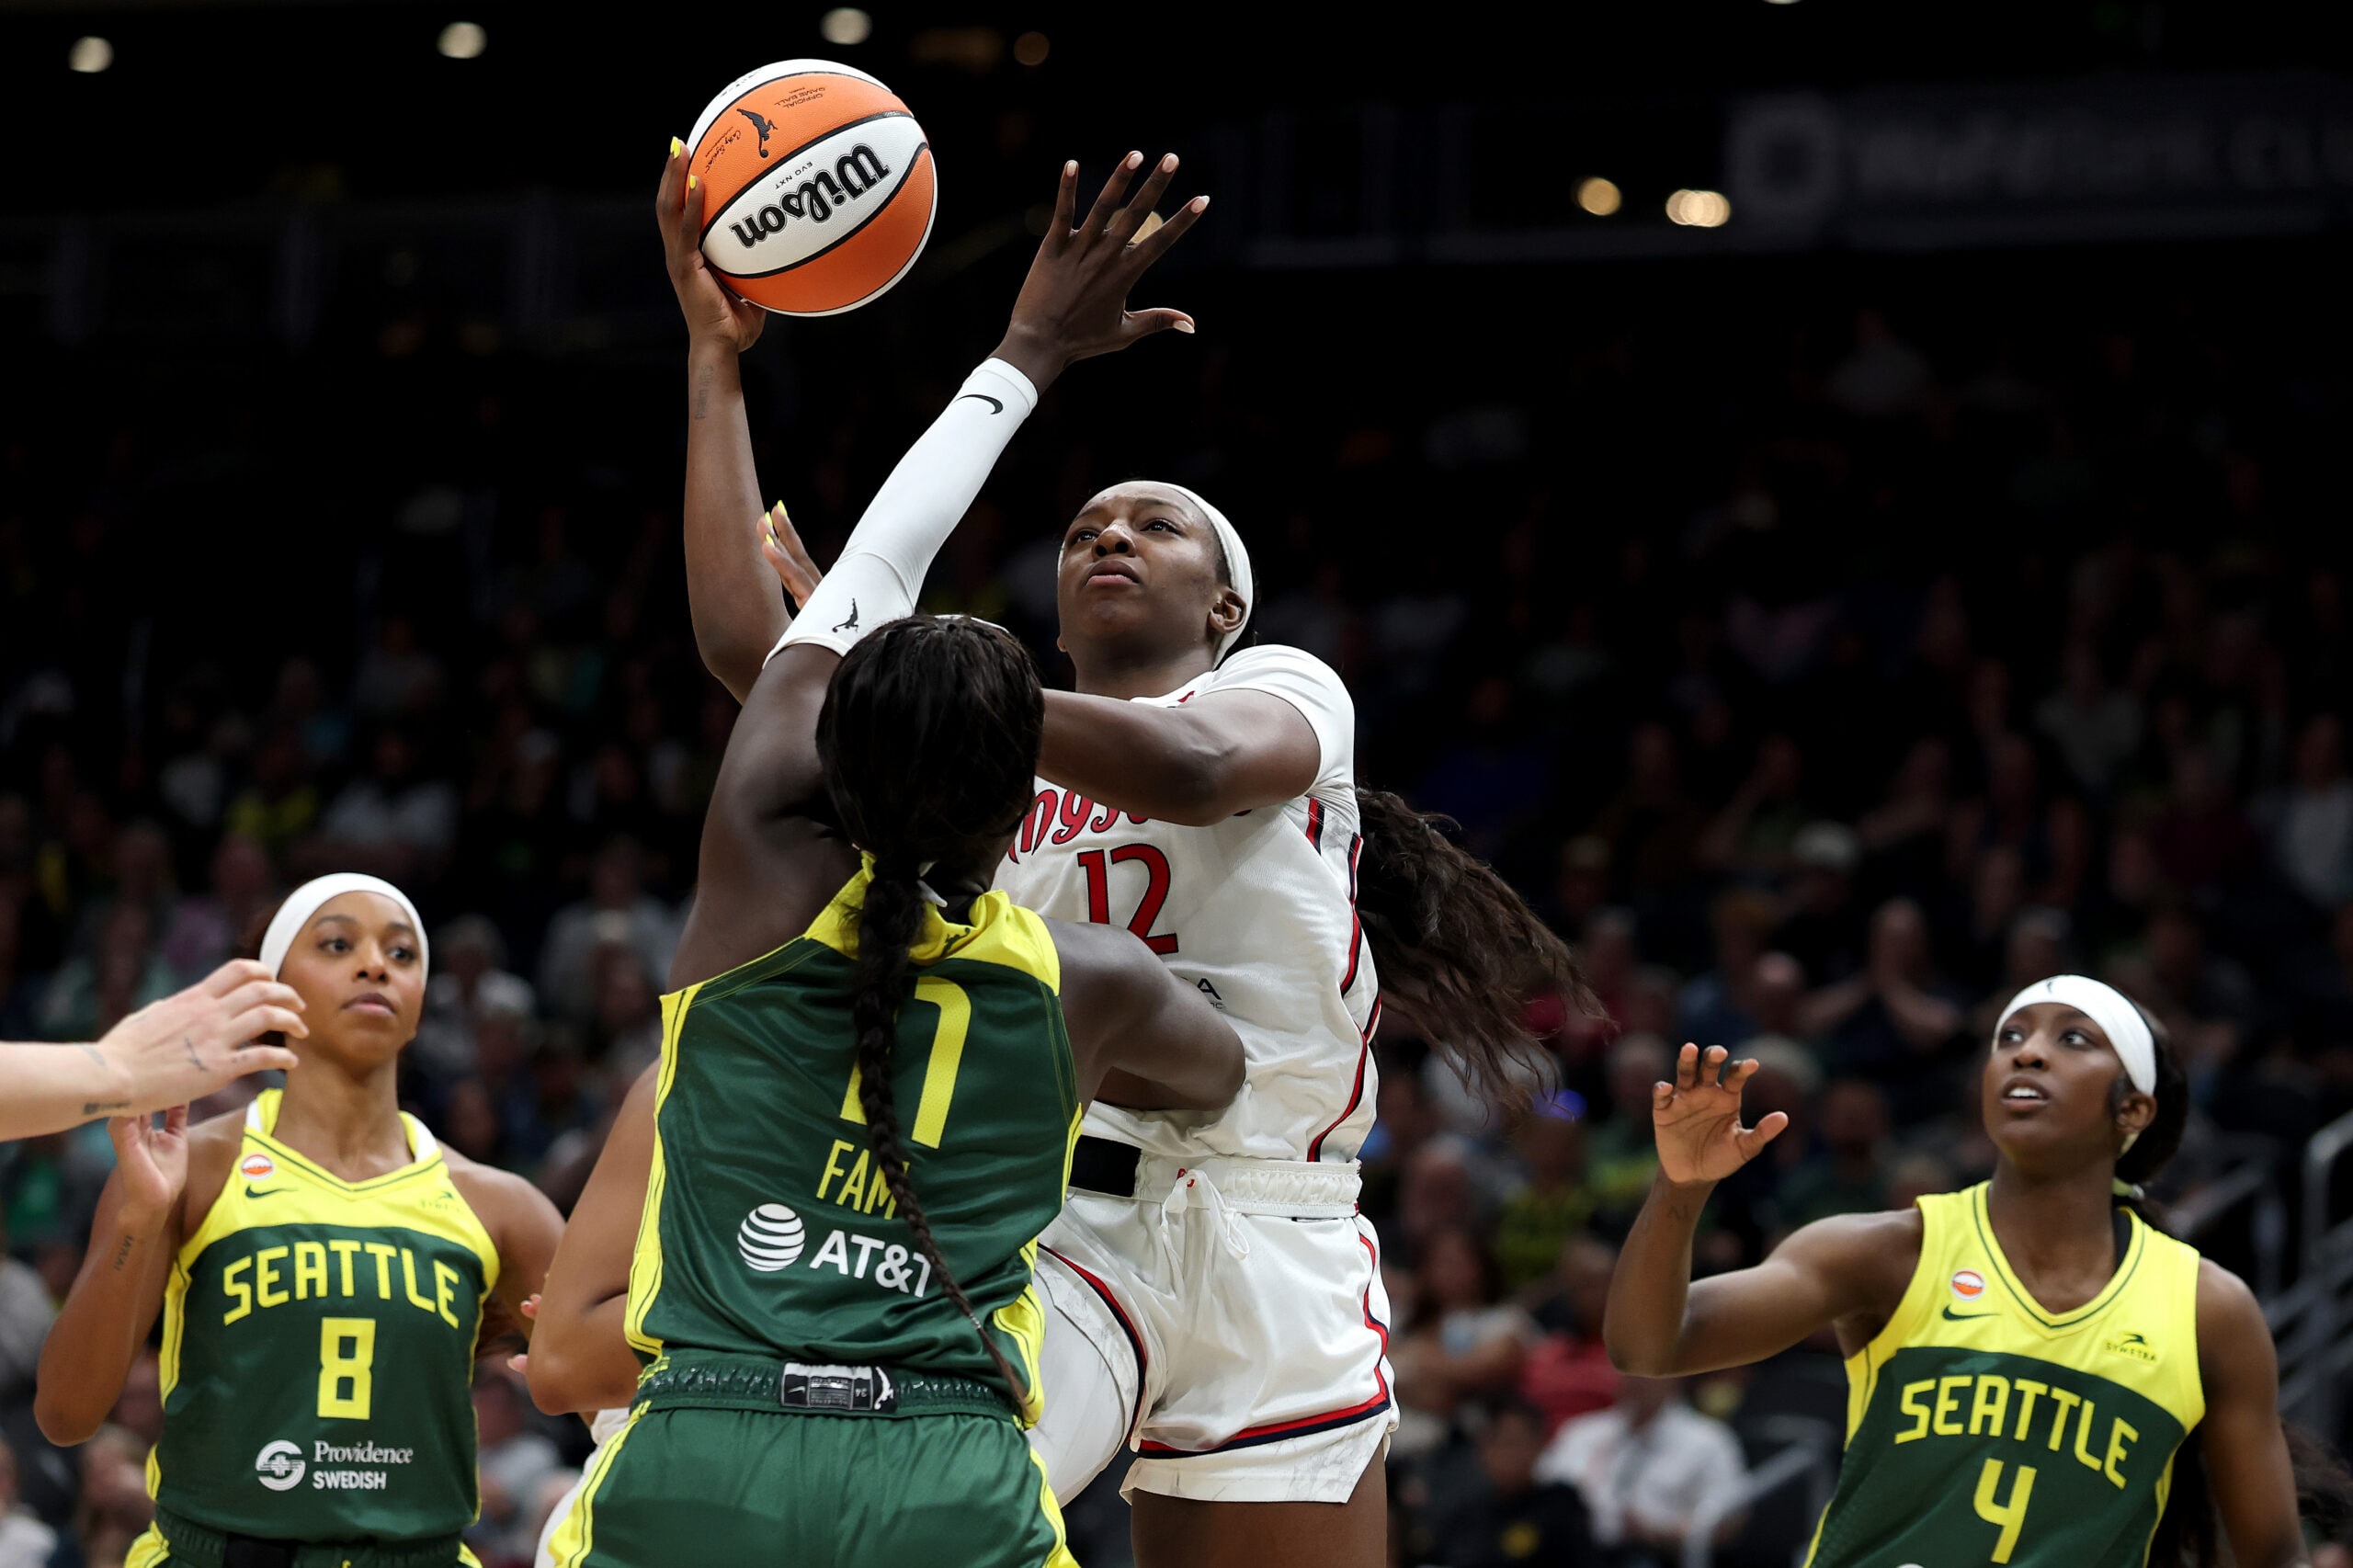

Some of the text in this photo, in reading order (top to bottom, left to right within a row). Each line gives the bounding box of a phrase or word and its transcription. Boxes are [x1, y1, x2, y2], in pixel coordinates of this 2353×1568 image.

[729, 142, 892, 249] Wilson
[775, 161, 813, 190] EVO NXT
[1077, 843, 1179, 955] 12
[223, 1239, 460, 1330] SEATTLE
[316, 1316, 377, 1421] 8
[313, 1439, 414, 1464] Providence
[313, 1470, 387, 1490] SWEDISH
[1894, 1374, 2140, 1490] SEATTLE
[1972, 1458, 2038, 1565] 4
